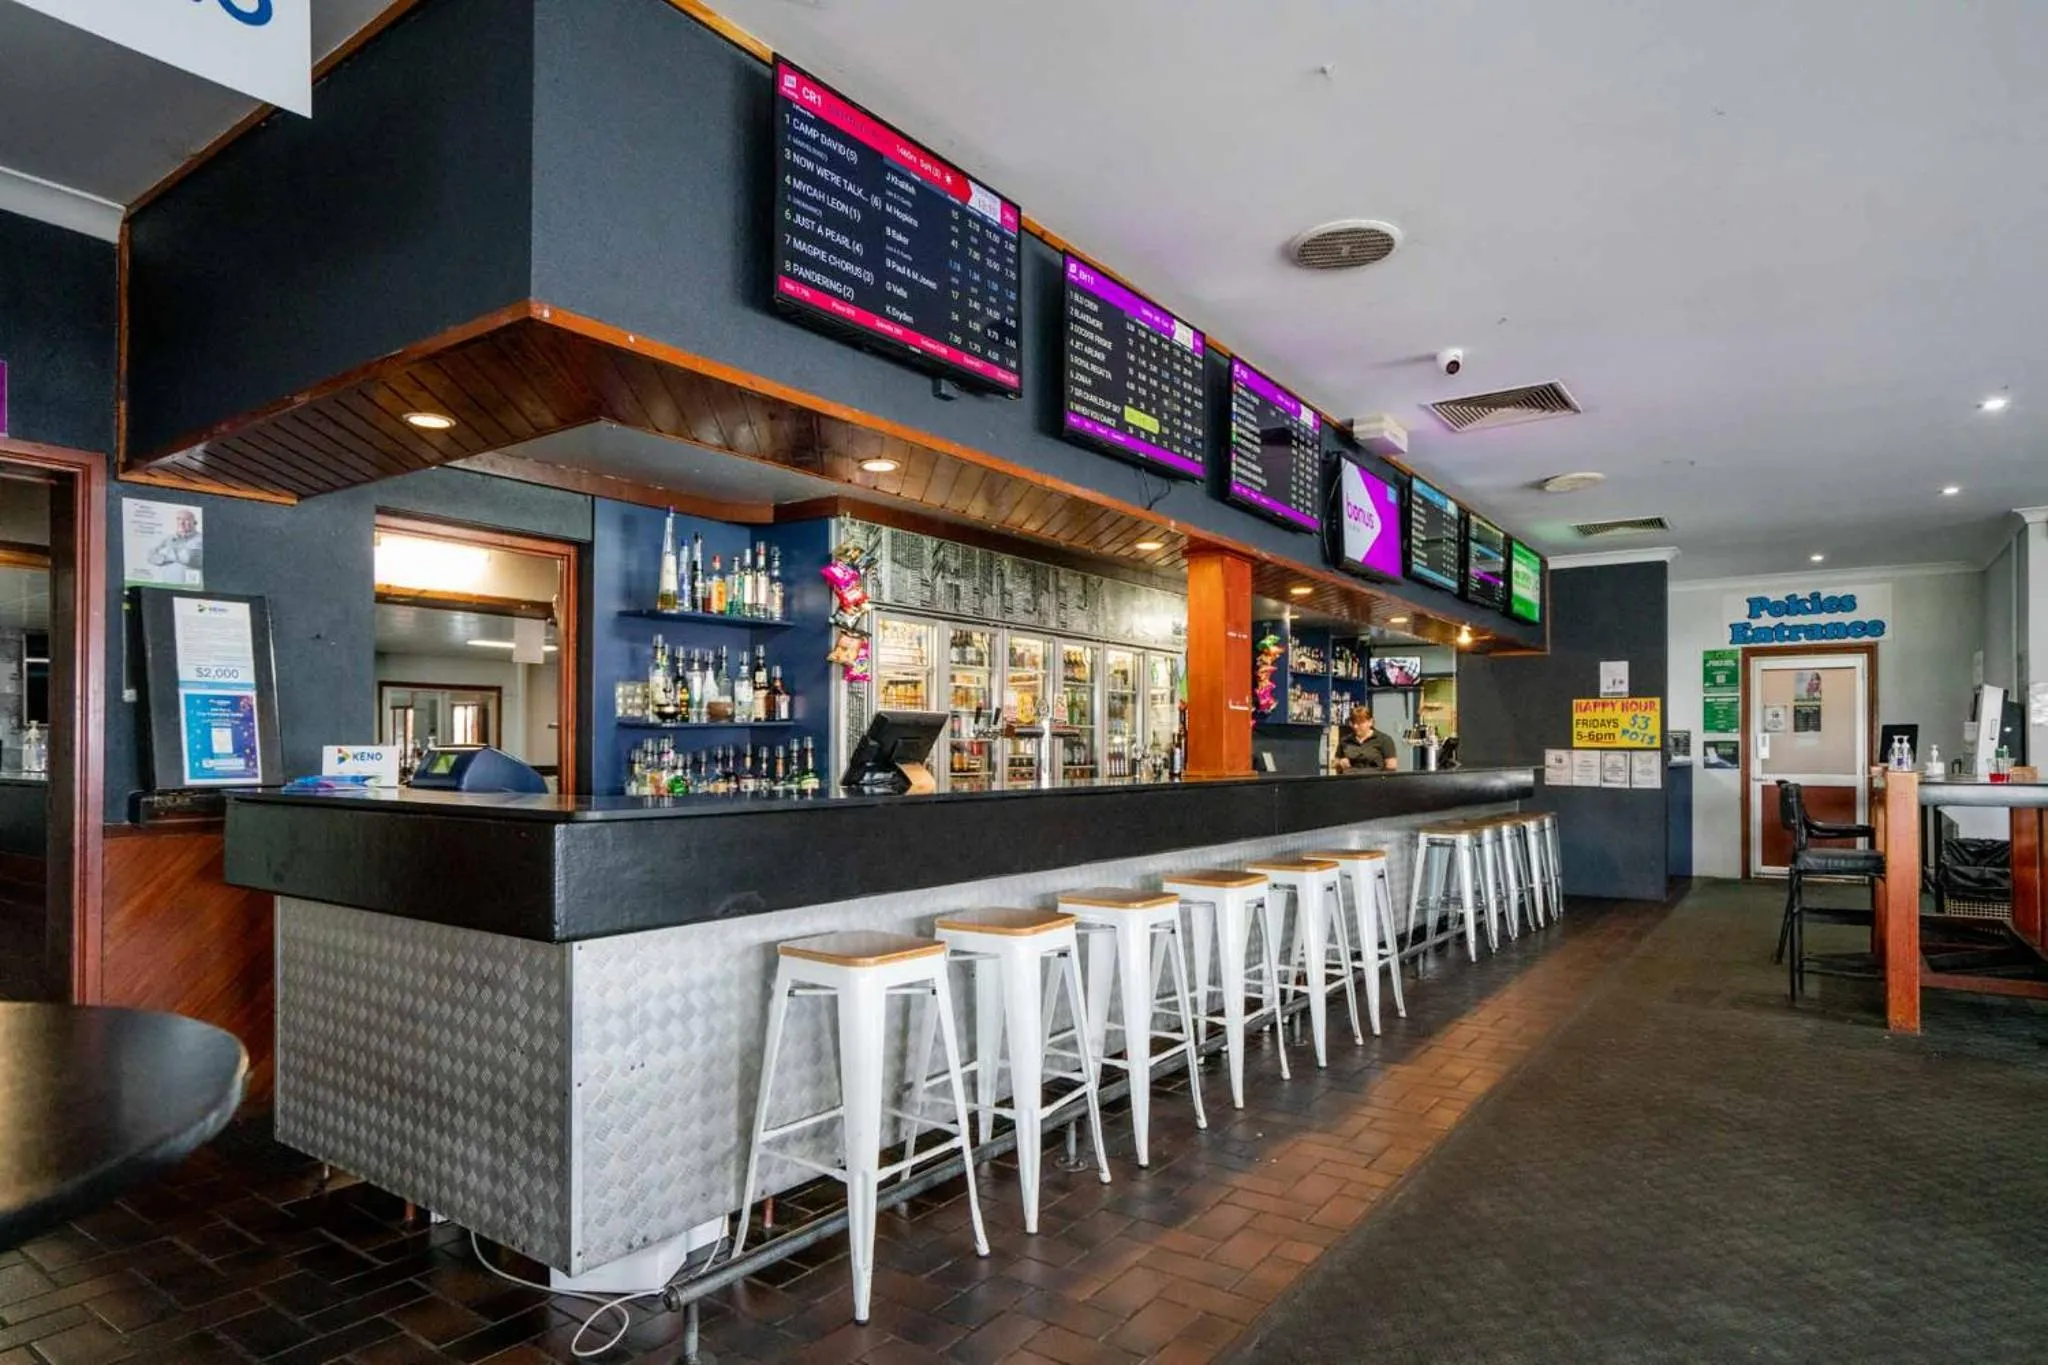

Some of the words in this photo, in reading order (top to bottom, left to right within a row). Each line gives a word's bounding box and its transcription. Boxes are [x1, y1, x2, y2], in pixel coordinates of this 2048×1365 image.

[793, 118, 819, 139] CAMP
[820, 134, 846, 156] DAVID
[785, 148, 791, 160] 3
[793, 152, 814, 172] NOW
[785, 174, 791, 185] 4
[793, 178, 825, 203] MYCAH
[826, 195, 848, 215] LEON
[785, 208, 791, 220] 6
[793, 214, 816, 230] JUST
[818, 225, 824, 236] A
[826, 228, 851, 250] PEARL
[785, 233, 791, 244] 7
[793, 237, 828, 262] MAGPIE
[828, 254, 862, 278] CHORUS
[793, 263, 842, 294] PANDERING
[1346, 492, 1374, 529] bonus
[1747, 592, 1857, 618] Pokies
[1729, 620, 1886, 644] Entrance
[196, 667, 240, 679] $2,000
[1576, 701, 1616, 713] HAPPY
[1622, 700, 1656, 713] HOUR
[1576, 718, 1619, 729] FRIDAYS
[1576, 730, 1616, 742] 5-6pm
[1621, 728, 1656, 744] POTS
[352, 752, 383, 763] KENO
